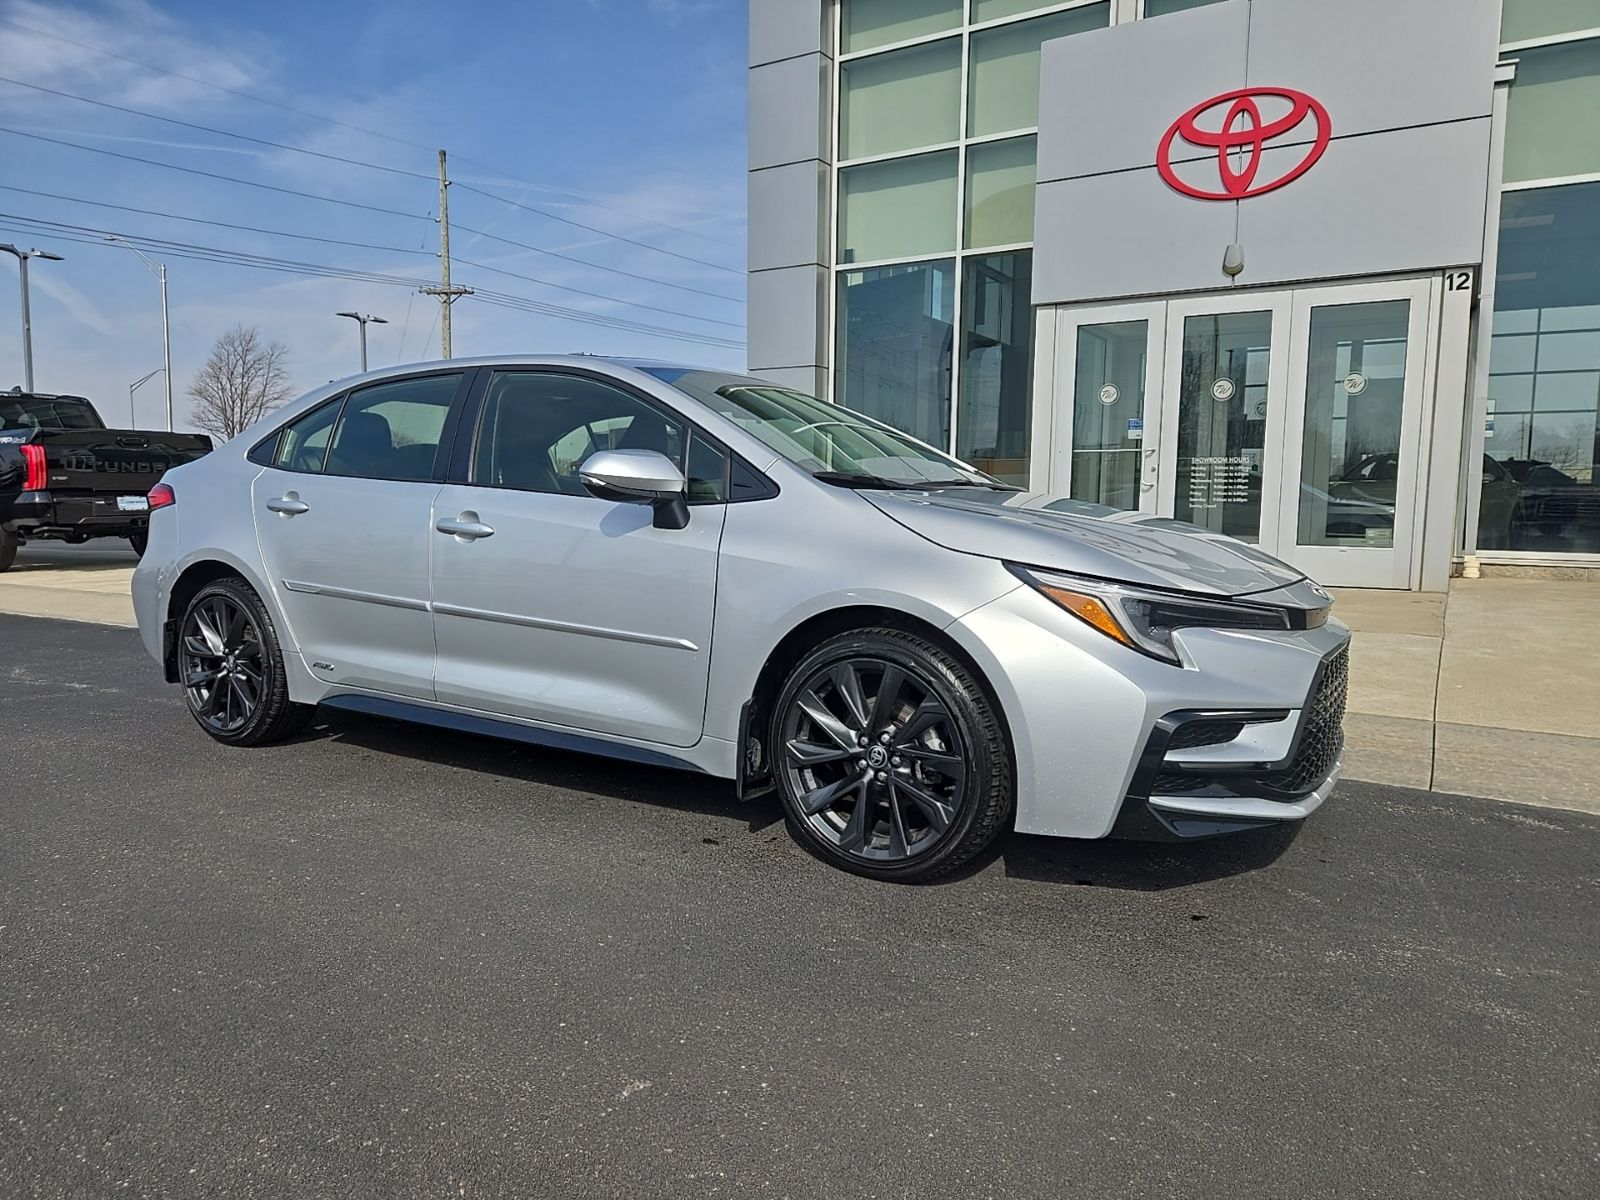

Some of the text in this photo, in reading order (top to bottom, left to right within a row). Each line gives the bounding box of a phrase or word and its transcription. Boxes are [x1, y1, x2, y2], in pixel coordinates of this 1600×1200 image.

[1446, 272, 1470, 291] 12
[1191, 456, 1250, 464] SHOWROOM HOURS
